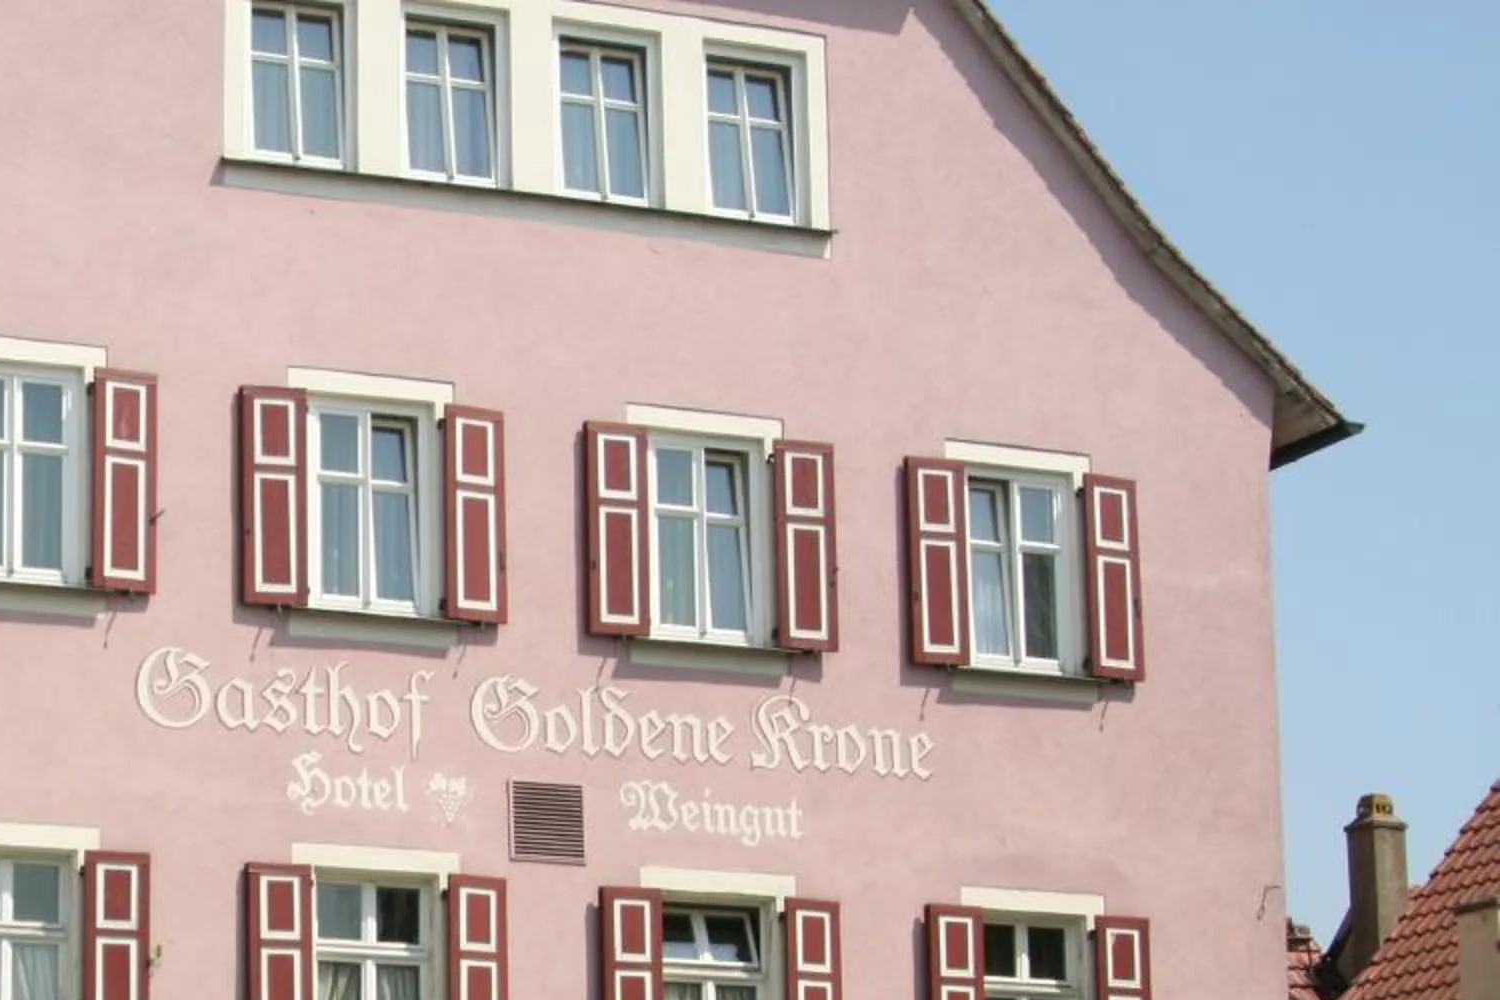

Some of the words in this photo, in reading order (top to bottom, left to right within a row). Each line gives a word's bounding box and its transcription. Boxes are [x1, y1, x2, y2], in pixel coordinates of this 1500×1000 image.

[136, 646, 435, 759] Gasthof
[470, 675, 734, 766] Goldene
[749, 694, 934, 779] Krone
[288, 751, 408, 814] Hotel
[620, 780, 803, 845] Weingut
